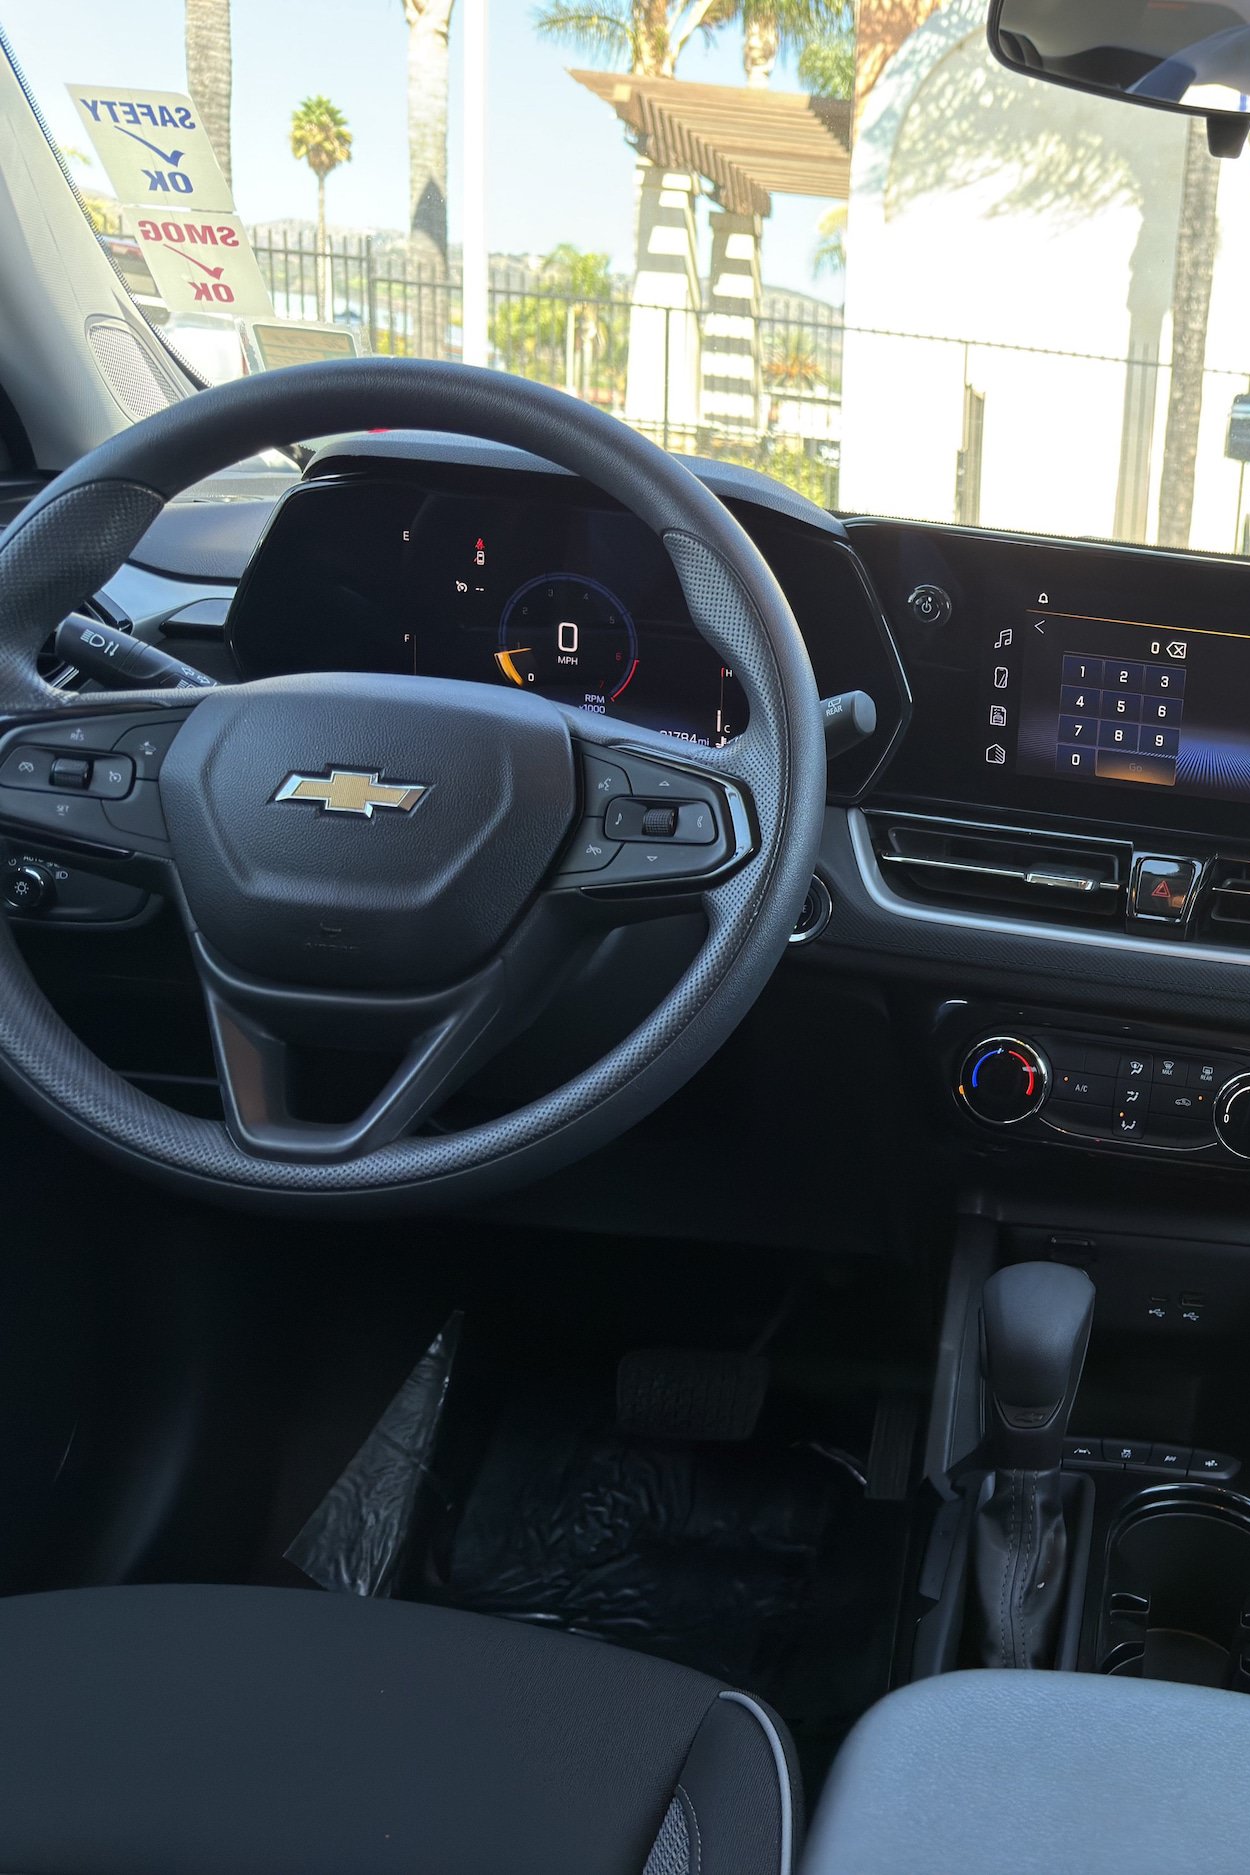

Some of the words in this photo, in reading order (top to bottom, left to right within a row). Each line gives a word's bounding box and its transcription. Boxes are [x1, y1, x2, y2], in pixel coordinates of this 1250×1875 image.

[403, 530, 410, 541] E
[404, 633, 410, 643] F
[558, 622, 579, 653] 0
[1150, 641, 1160, 655] 0
[557, 655, 578, 666] MPH
[528, 673, 535, 682] 0
[725, 668, 733, 678] H
[1080, 665, 1085, 678] 1
[1119, 670, 1129, 683] 2
[1160, 675, 1169, 688] 3
[584, 693, 605, 704] RPM
[825, 705, 843, 717] REAR
[1075, 695, 1085, 708] 4
[1116, 700, 1126, 713] 5
[1157, 705, 1167, 718] 6
[723, 724, 731, 734] C
[1074, 724, 1083, 737] 7
[1114, 729, 1124, 742] 8
[1155, 734, 1164, 747] 9
[1071, 753, 1081, 766] 0
[1128, 762, 1143, 774] Go
[57, 804, 70, 813] SET
[1074, 1083, 1088, 1094] A/C
